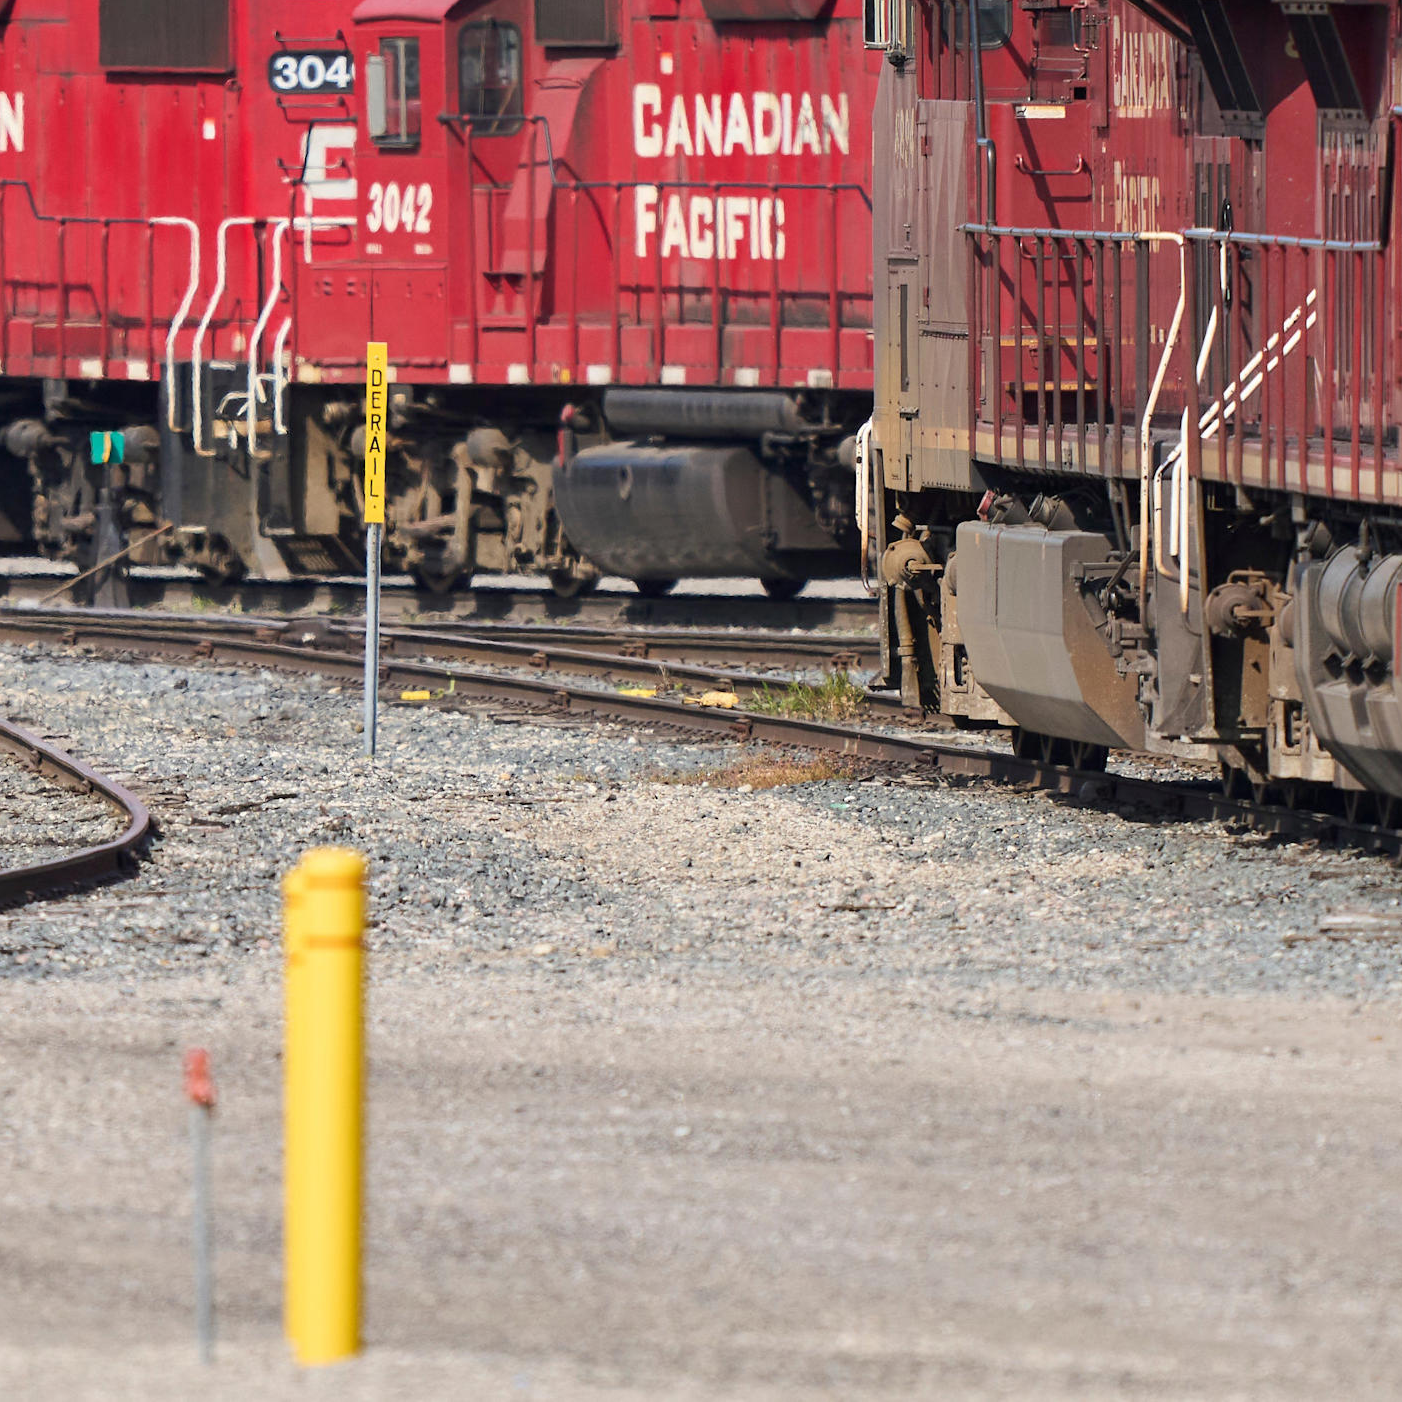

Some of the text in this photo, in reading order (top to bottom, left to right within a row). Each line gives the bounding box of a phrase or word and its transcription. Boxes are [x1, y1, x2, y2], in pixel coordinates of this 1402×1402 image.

[273, 55, 356, 90] 304
[633, 83, 850, 158] CANADIAN
[366, 181, 433, 234] 3042
[634, 184, 786, 260] PACIFIC
[369, 368, 383, 498] DERAIL
